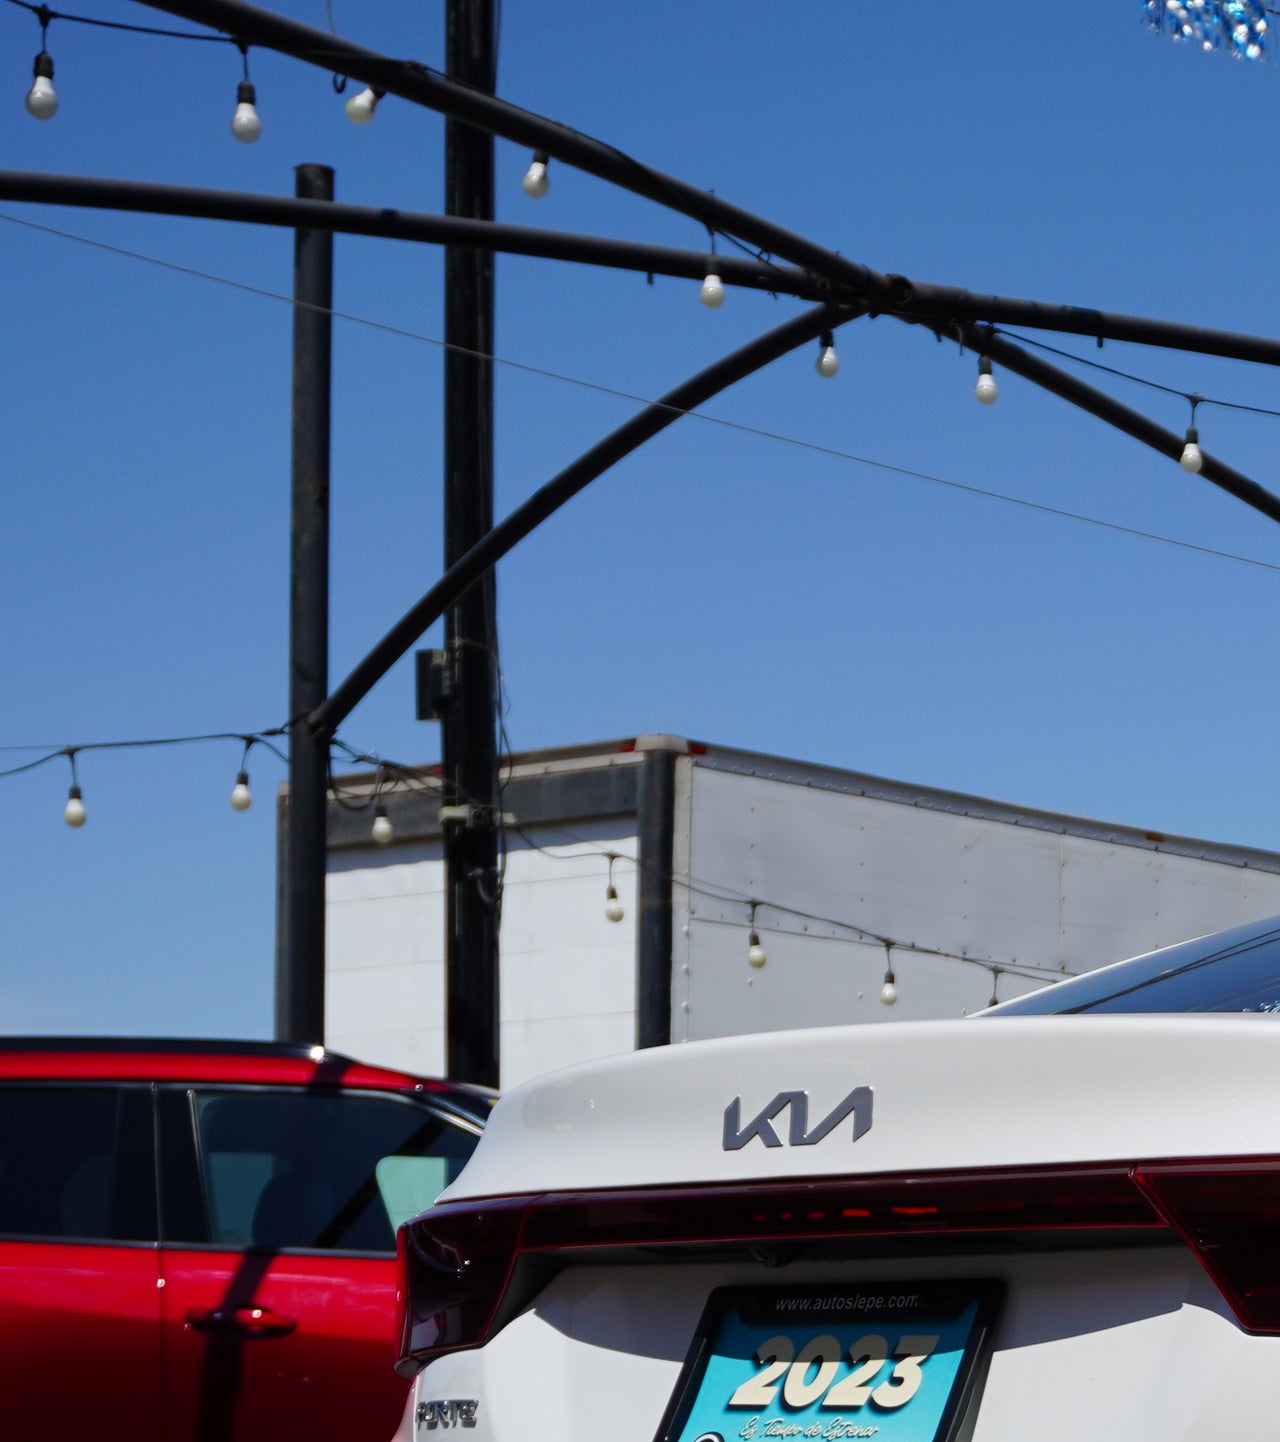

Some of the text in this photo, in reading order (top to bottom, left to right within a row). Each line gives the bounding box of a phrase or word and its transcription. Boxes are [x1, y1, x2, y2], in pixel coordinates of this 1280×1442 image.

[723, 1086, 874, 1151] KIA
[776, 1292, 919, 1312] www.autoslepe.com
[729, 1334, 940, 1408] 2023
[804, 1421, 822, 1436] de
